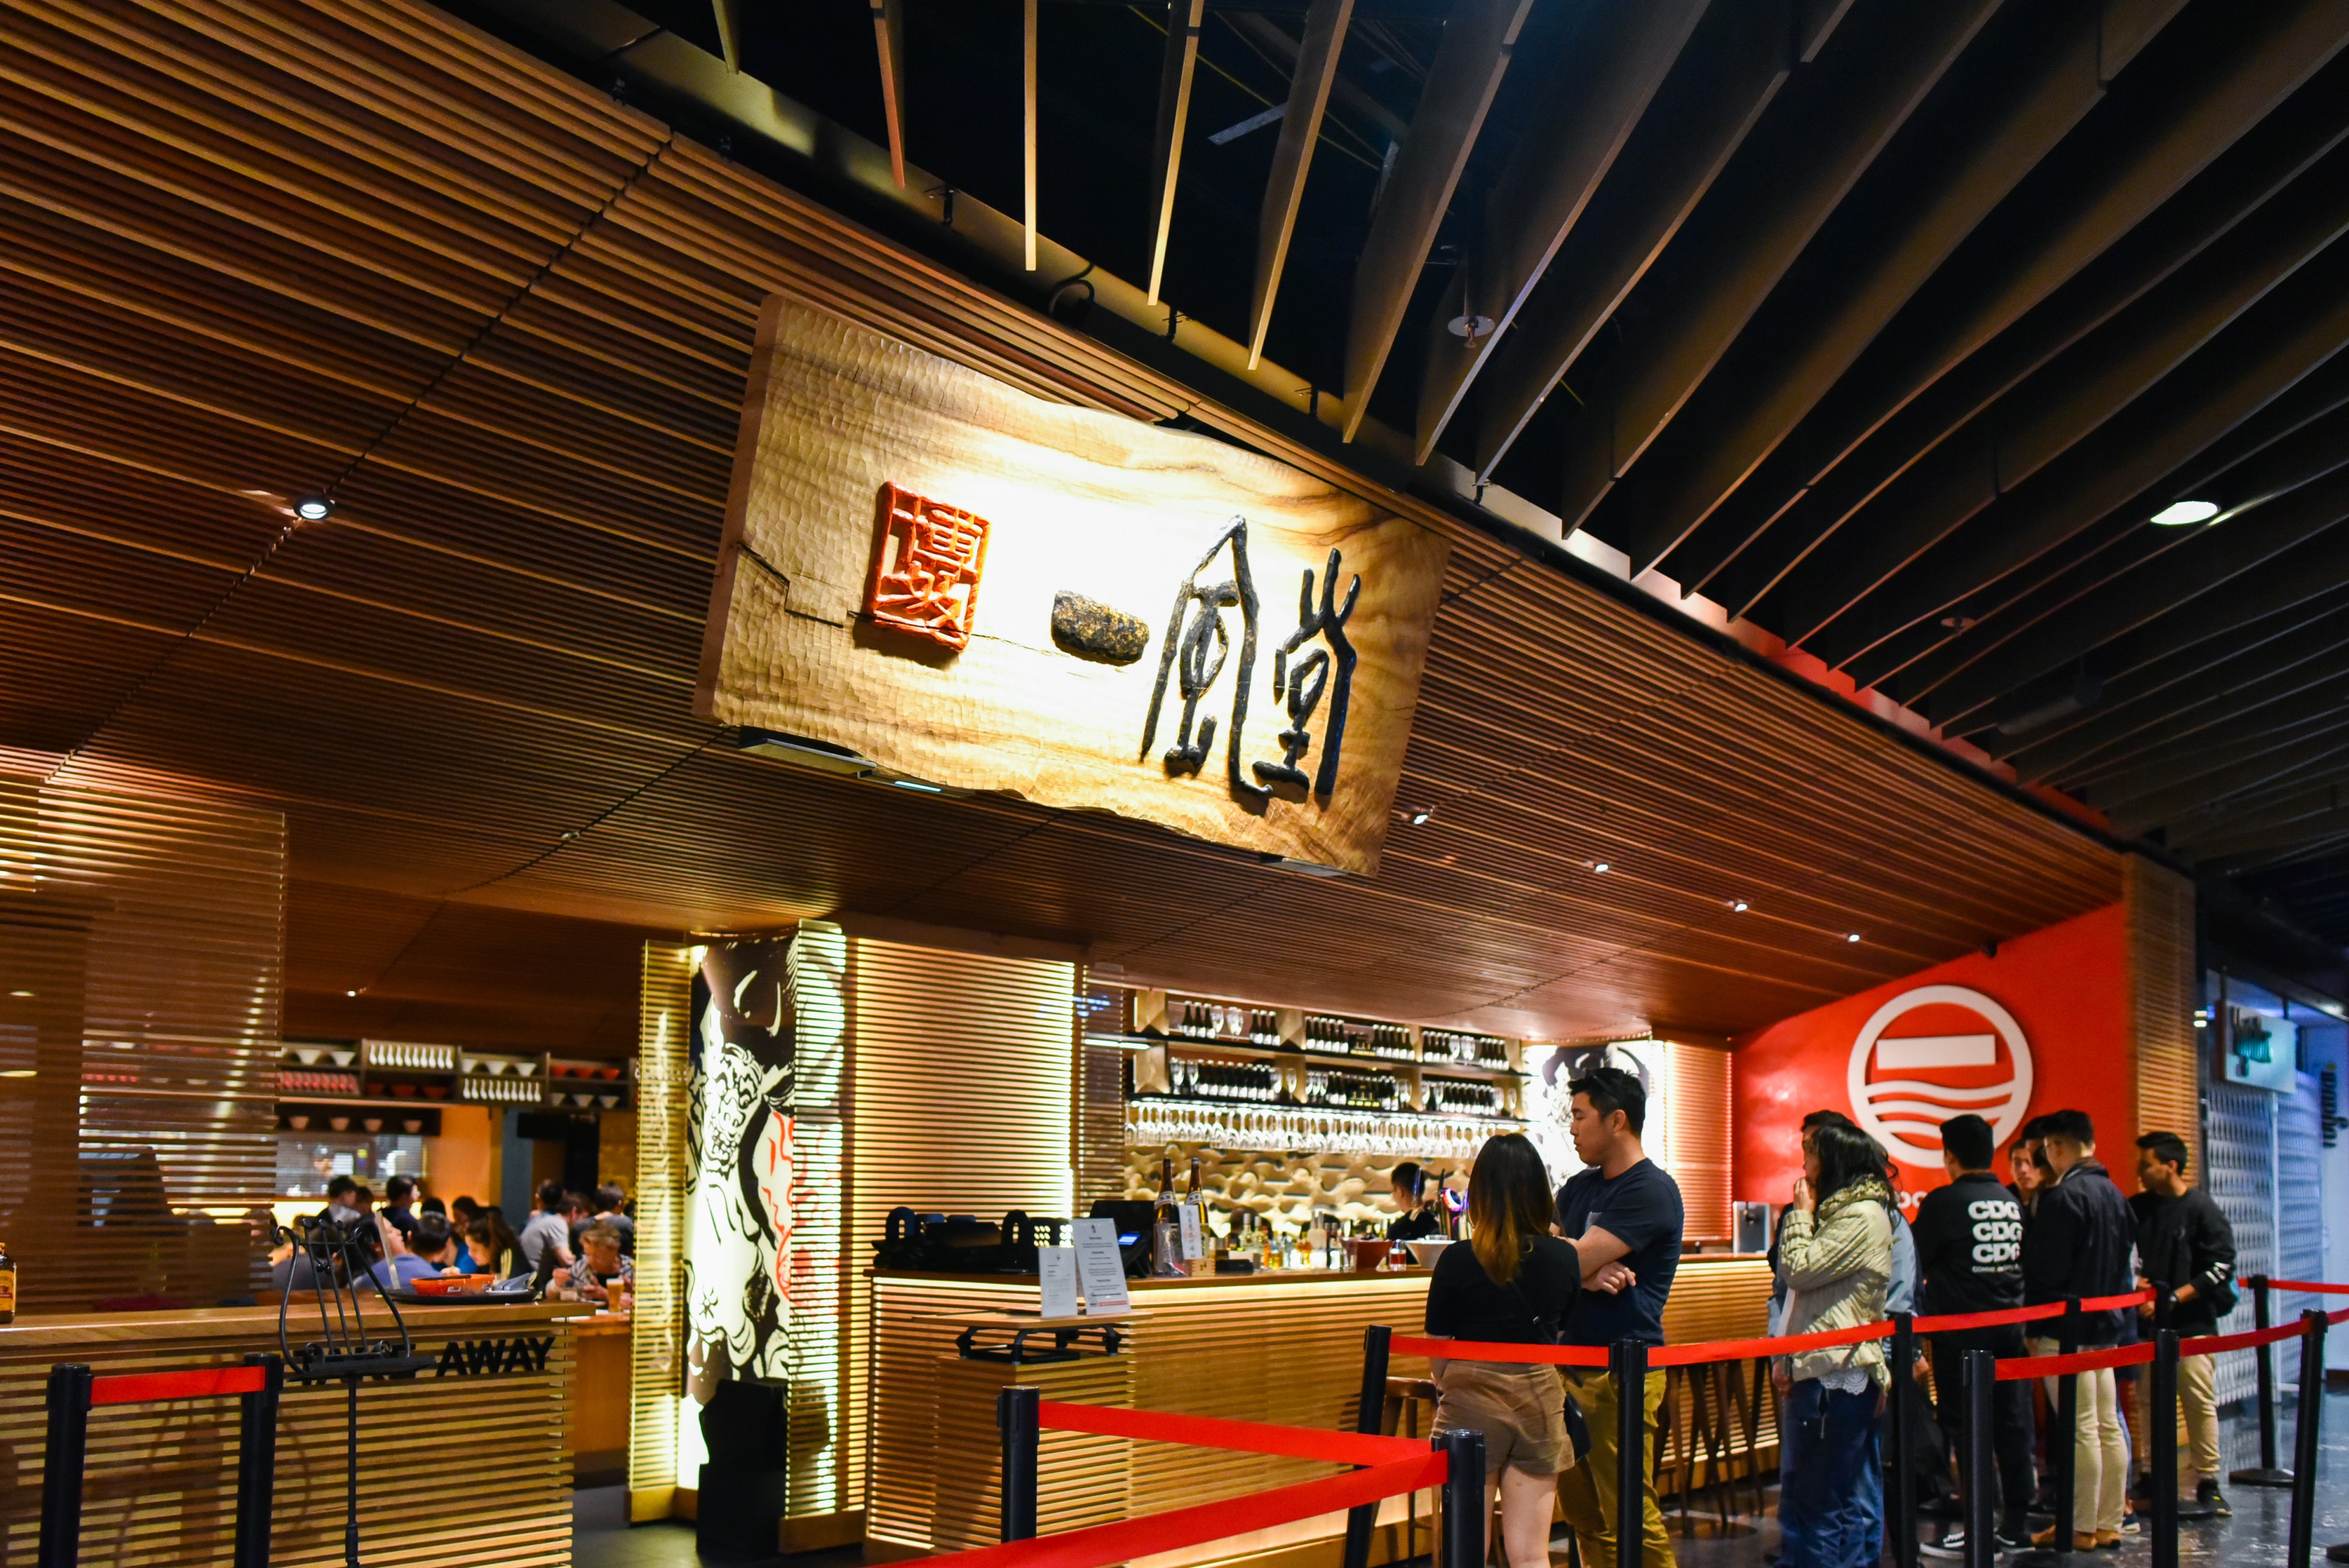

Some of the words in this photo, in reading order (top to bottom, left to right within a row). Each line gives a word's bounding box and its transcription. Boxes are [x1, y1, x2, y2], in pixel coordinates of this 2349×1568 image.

[1968, 1200, 2021, 1220] CDG
[1972, 1221, 2023, 1242] CDG
[1971, 1243, 2021, 1263] CDG
[436, 1337, 556, 1377] AWAY
